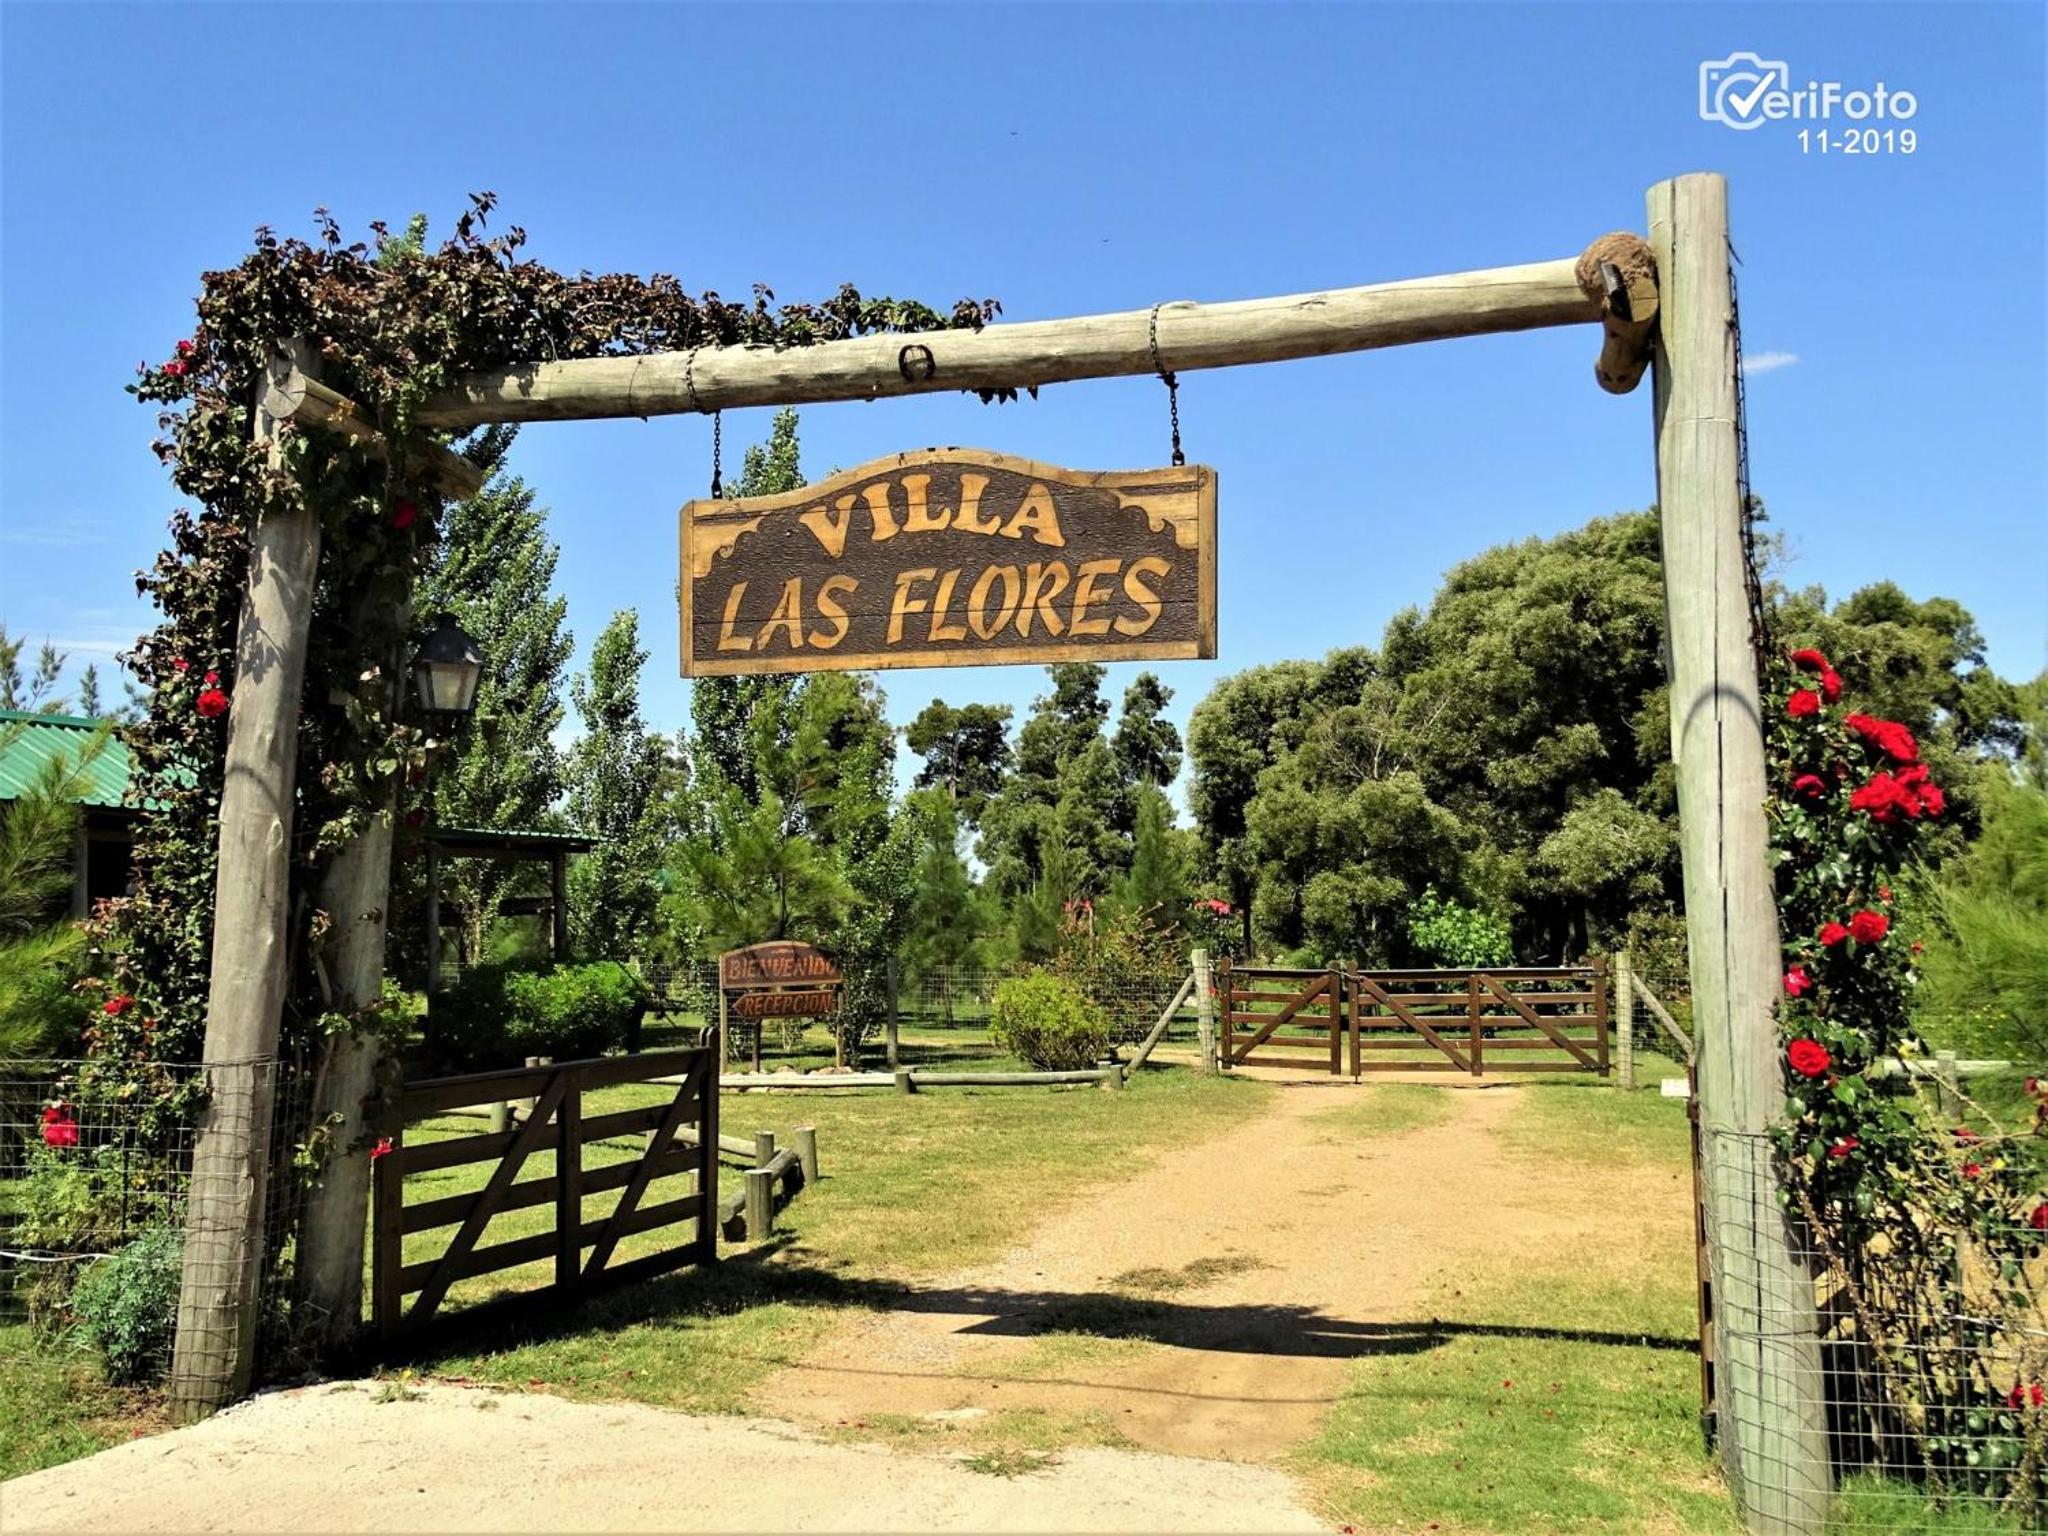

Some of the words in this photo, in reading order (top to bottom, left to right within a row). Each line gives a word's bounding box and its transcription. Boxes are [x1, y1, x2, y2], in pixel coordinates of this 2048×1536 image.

[800, 473, 1066, 559] VILLA
[717, 574, 860, 651] LAS
[887, 556, 1172, 645] FLORES
